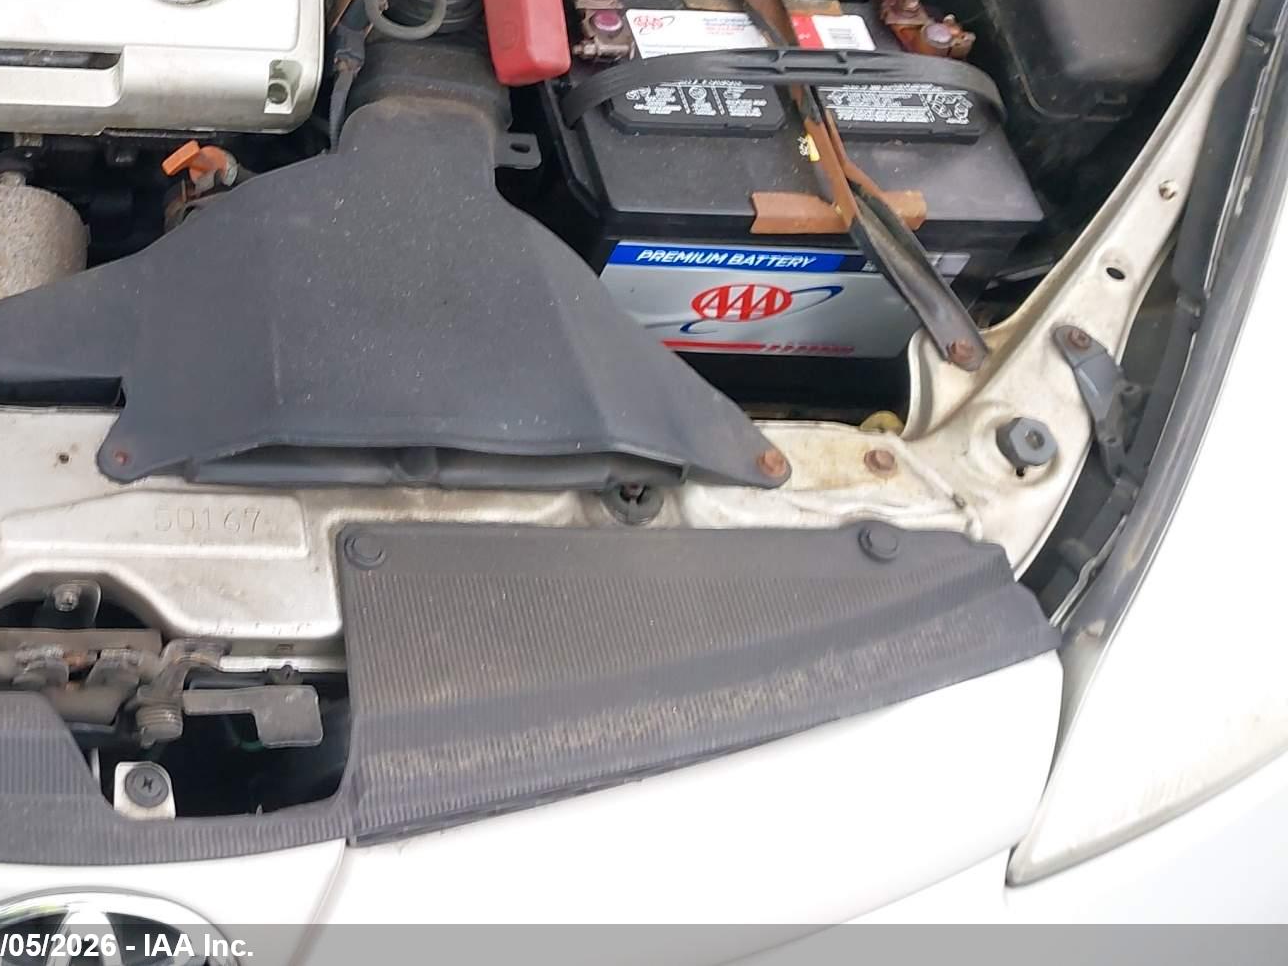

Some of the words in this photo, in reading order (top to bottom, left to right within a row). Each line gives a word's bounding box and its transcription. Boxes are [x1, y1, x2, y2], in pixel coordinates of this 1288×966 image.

[636, 249, 729, 266] PREMIUM
[729, 253, 817, 269] BATTERY
[691, 283, 792, 322] AAA
